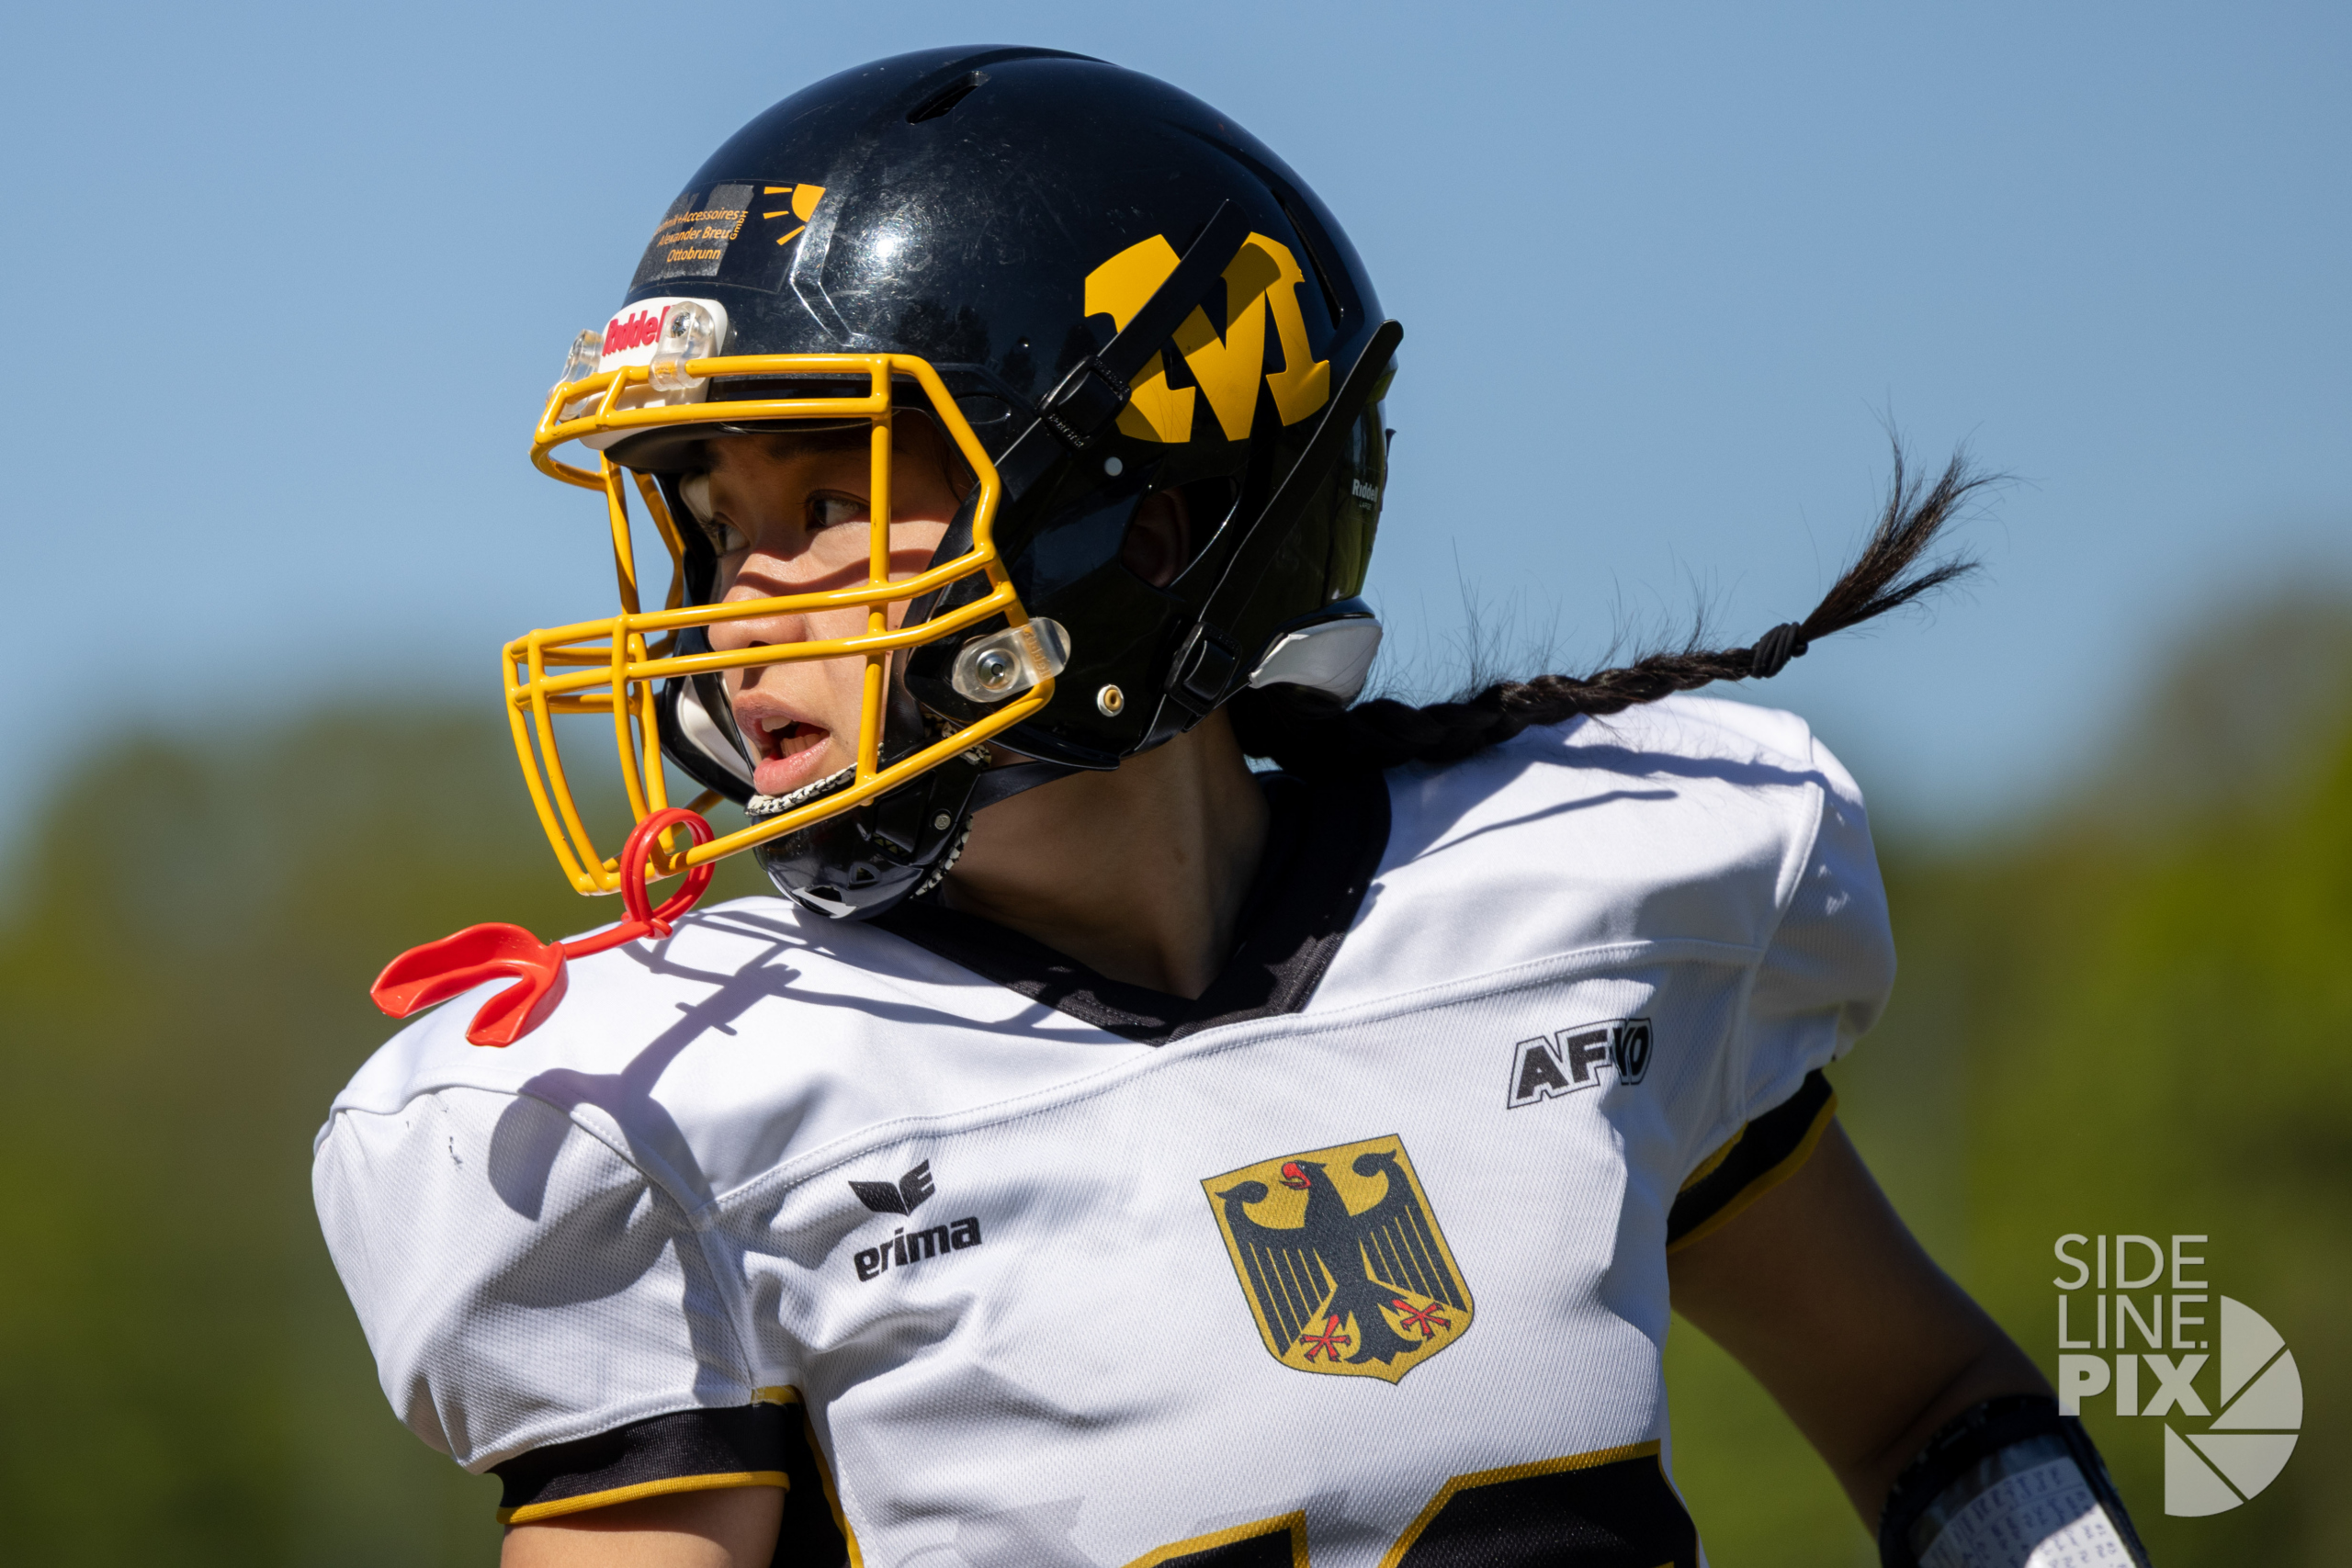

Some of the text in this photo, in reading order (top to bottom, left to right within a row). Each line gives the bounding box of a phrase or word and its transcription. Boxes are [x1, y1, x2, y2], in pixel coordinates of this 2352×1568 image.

[657, 227, 701, 247] Alexander
[729, 210, 749, 241] GmbH
[667, 246, 721, 263] Ottobrunn
[602, 305, 673, 357] Riddel
[1352, 479, 1378, 502] Riddell
[854, 1216, 982, 1282] erima
